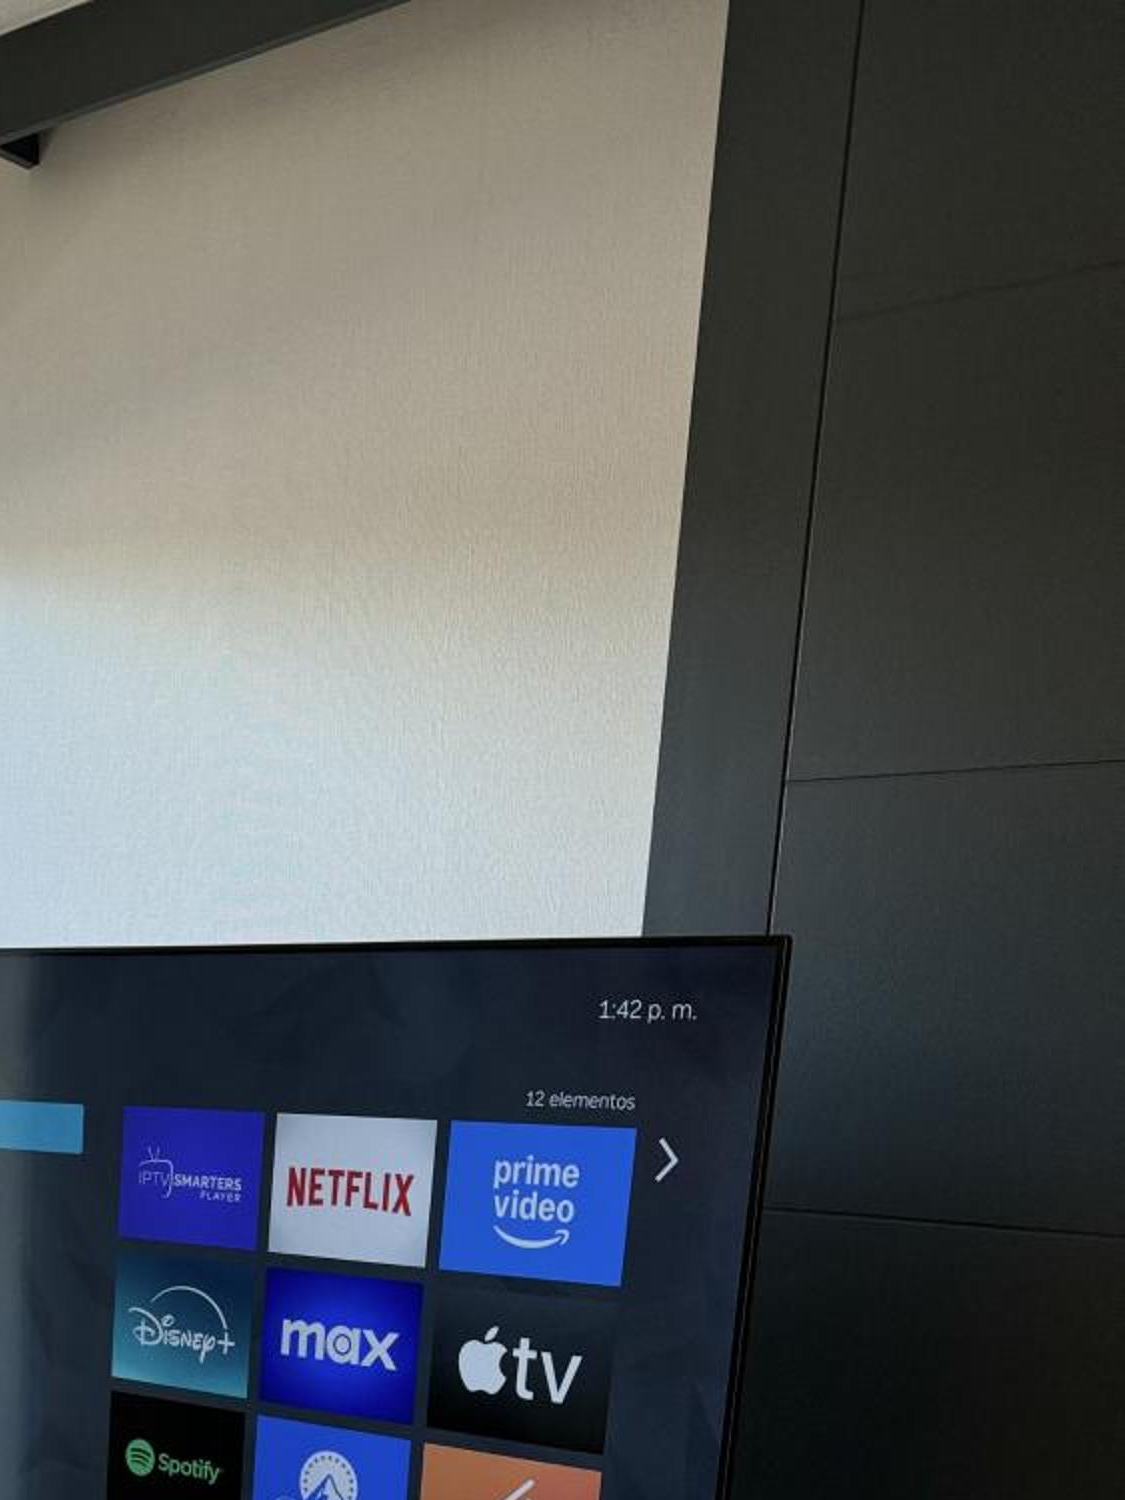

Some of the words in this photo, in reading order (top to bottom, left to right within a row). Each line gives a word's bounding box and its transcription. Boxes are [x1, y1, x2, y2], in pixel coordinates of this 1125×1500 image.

[598, 999, 642, 1019] 1:42
[647, 1003, 666, 1024] p.
[672, 1003, 697, 1020] m.
[526, 1089, 545, 1107] 12
[549, 1091, 636, 1111] elementos
[174, 1173, 242, 1192] SMARTERS
[493, 1154, 581, 1188] prime
[286, 1167, 415, 1217] NETFLIX
[493, 1191, 576, 1225] video
[128, 1307, 236, 1364] Disney+
[281, 1317, 400, 1372] max
[512, 1335, 584, 1405] tv
[157, 1452, 221, 1486] Spotify
